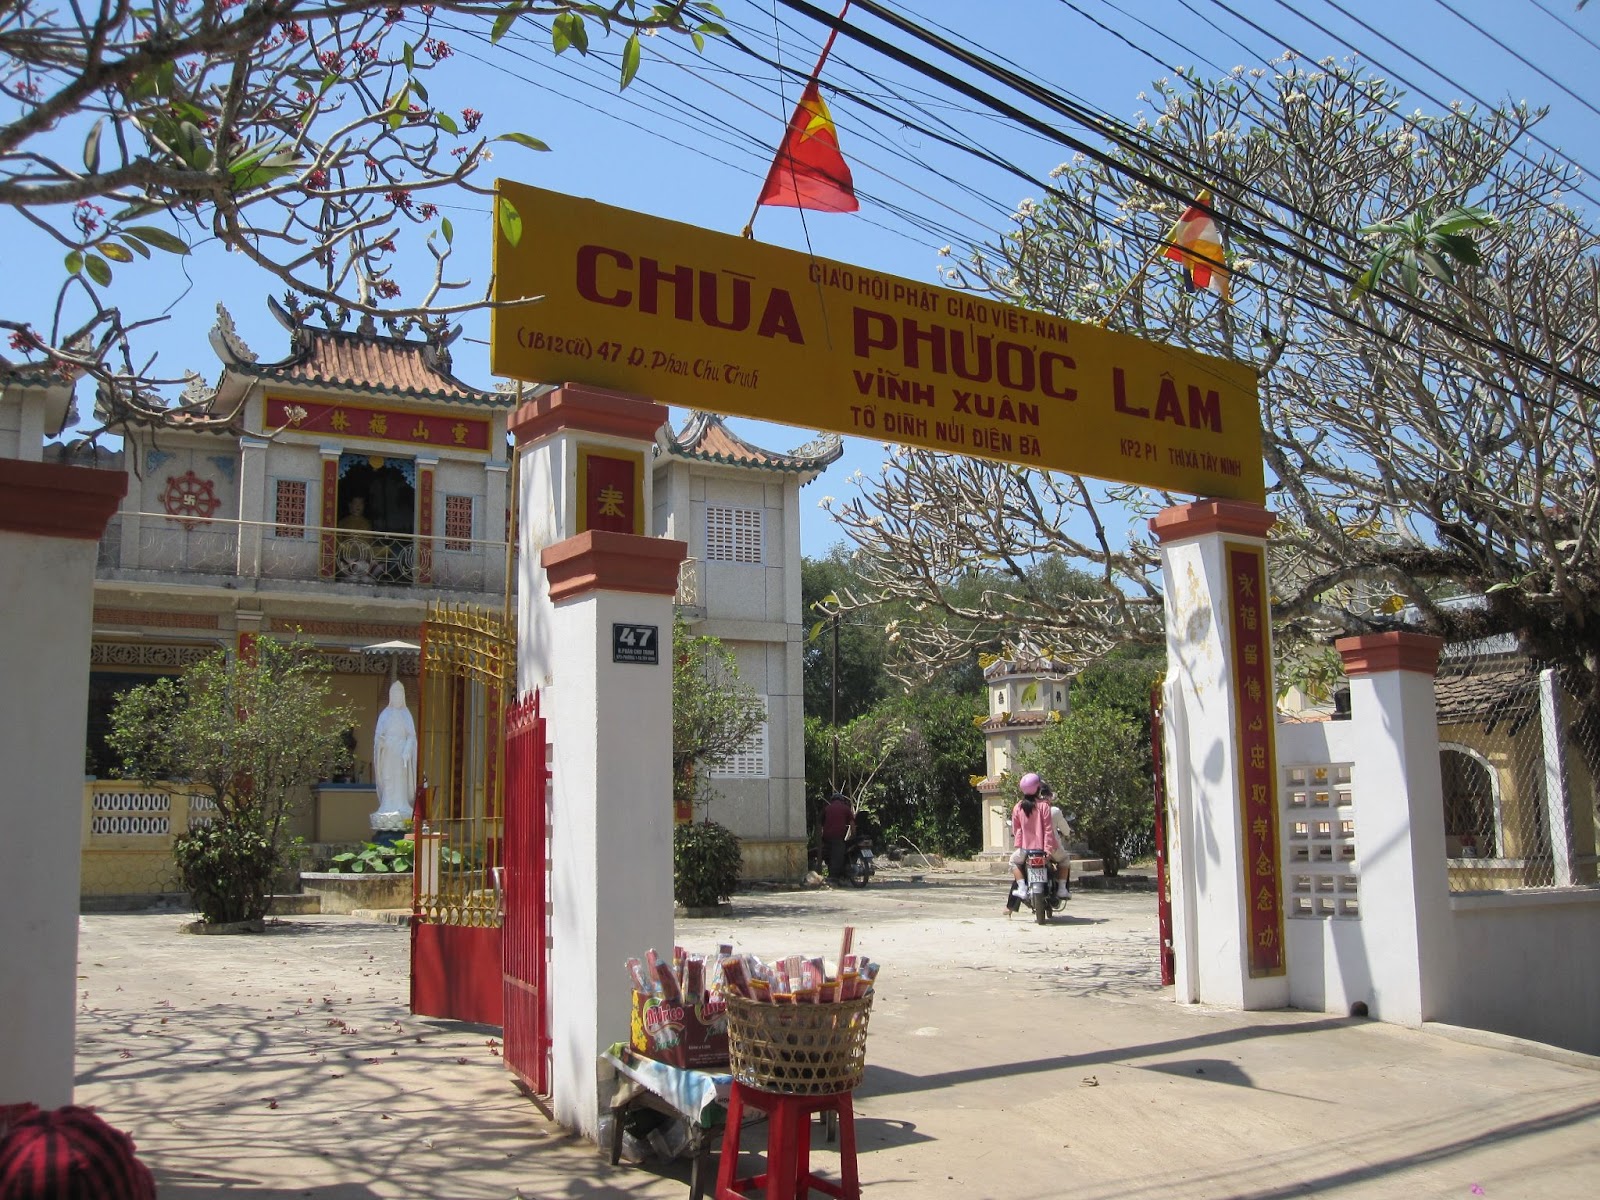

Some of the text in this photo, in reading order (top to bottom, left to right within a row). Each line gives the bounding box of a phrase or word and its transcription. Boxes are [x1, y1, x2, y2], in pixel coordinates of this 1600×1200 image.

[858, 275, 889, 301] HỘI
[893, 283, 939, 312] PHẬT
[576, 244, 805, 345] CHÙA
[1112, 366, 1222, 433] LÂM
[597, 341, 622, 362] 47
[651, 350, 689, 376] Phan
[692, 358, 719, 381] Chu
[853, 368, 1040, 426] VĨNH XUÂN
[1120, 438, 1141, 459] KP2
[620, 627, 652, 646] 47
